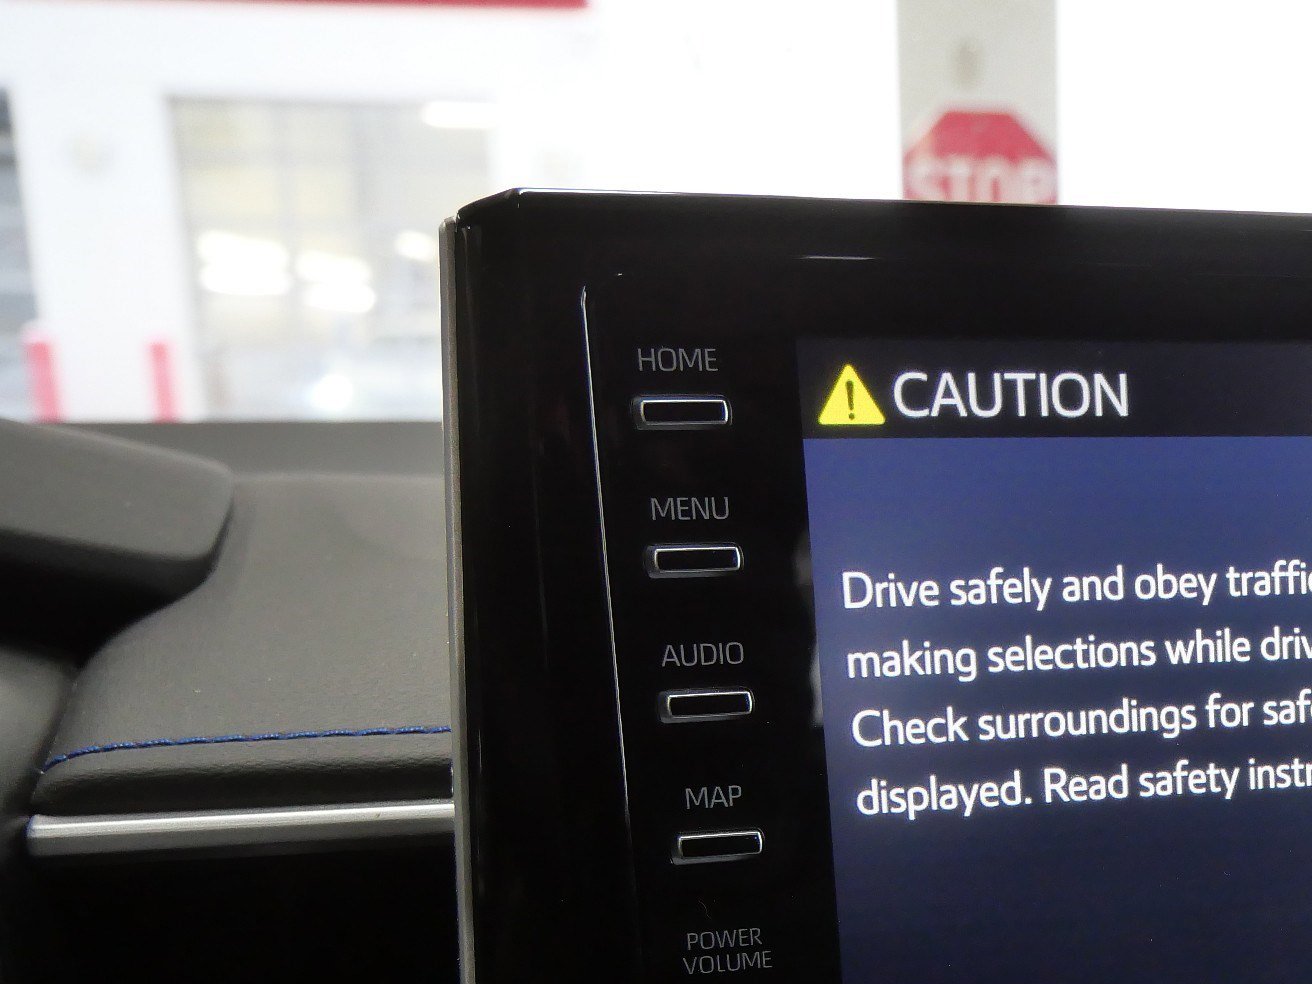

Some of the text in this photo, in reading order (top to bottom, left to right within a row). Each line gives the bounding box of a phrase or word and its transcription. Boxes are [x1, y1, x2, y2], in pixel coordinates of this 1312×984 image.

[637, 347, 719, 372] HOME
[893, 371, 1129, 417] CAUTION
[650, 496, 730, 521] MENU
[843, 571, 940, 609] Drive
[950, 567, 1052, 612] safely
[1062, 564, 1124, 602] and
[1134, 564, 1217, 605] obey
[661, 641, 744, 667] AUDIO
[847, 640, 977, 682] making
[987, 635, 1158, 674] selections
[1165, 628, 1251, 664] while
[851, 706, 969, 747] Check
[978, 697, 1197, 739] surroundings
[1205, 692, 1254, 729] for
[685, 785, 742, 810] MAP
[856, 769, 1032, 820] displayed.
[1042, 764, 1130, 803] Read
[1139, 759, 1240, 800] safety
[686, 927, 763, 950] POWER
[682, 950, 773, 975] VOLUME
